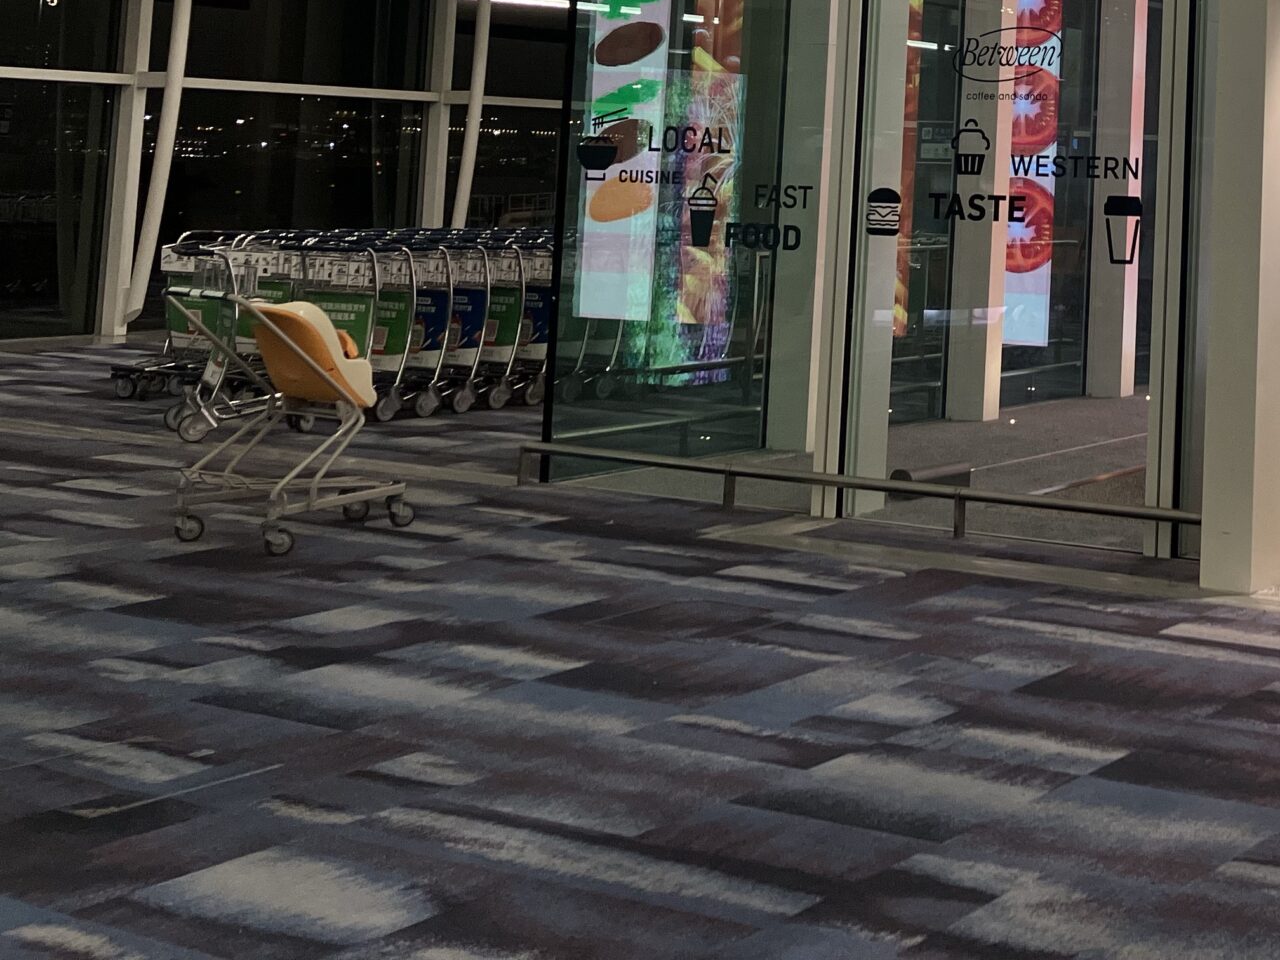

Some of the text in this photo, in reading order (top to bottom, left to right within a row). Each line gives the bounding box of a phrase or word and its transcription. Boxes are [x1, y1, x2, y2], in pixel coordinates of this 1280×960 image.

[963, 37, 1056, 67] Between
[966, 91, 996, 101] coffee
[998, 91, 1016, 101] and
[647, 125, 732, 155] LOCAL
[618, 168, 683, 186] CUISINE
[1011, 154, 1140, 181] WESTERN
[754, 184, 814, 211] FAST
[928, 192, 1027, 223] TASTE
[725, 222, 802, 252] FOOD
